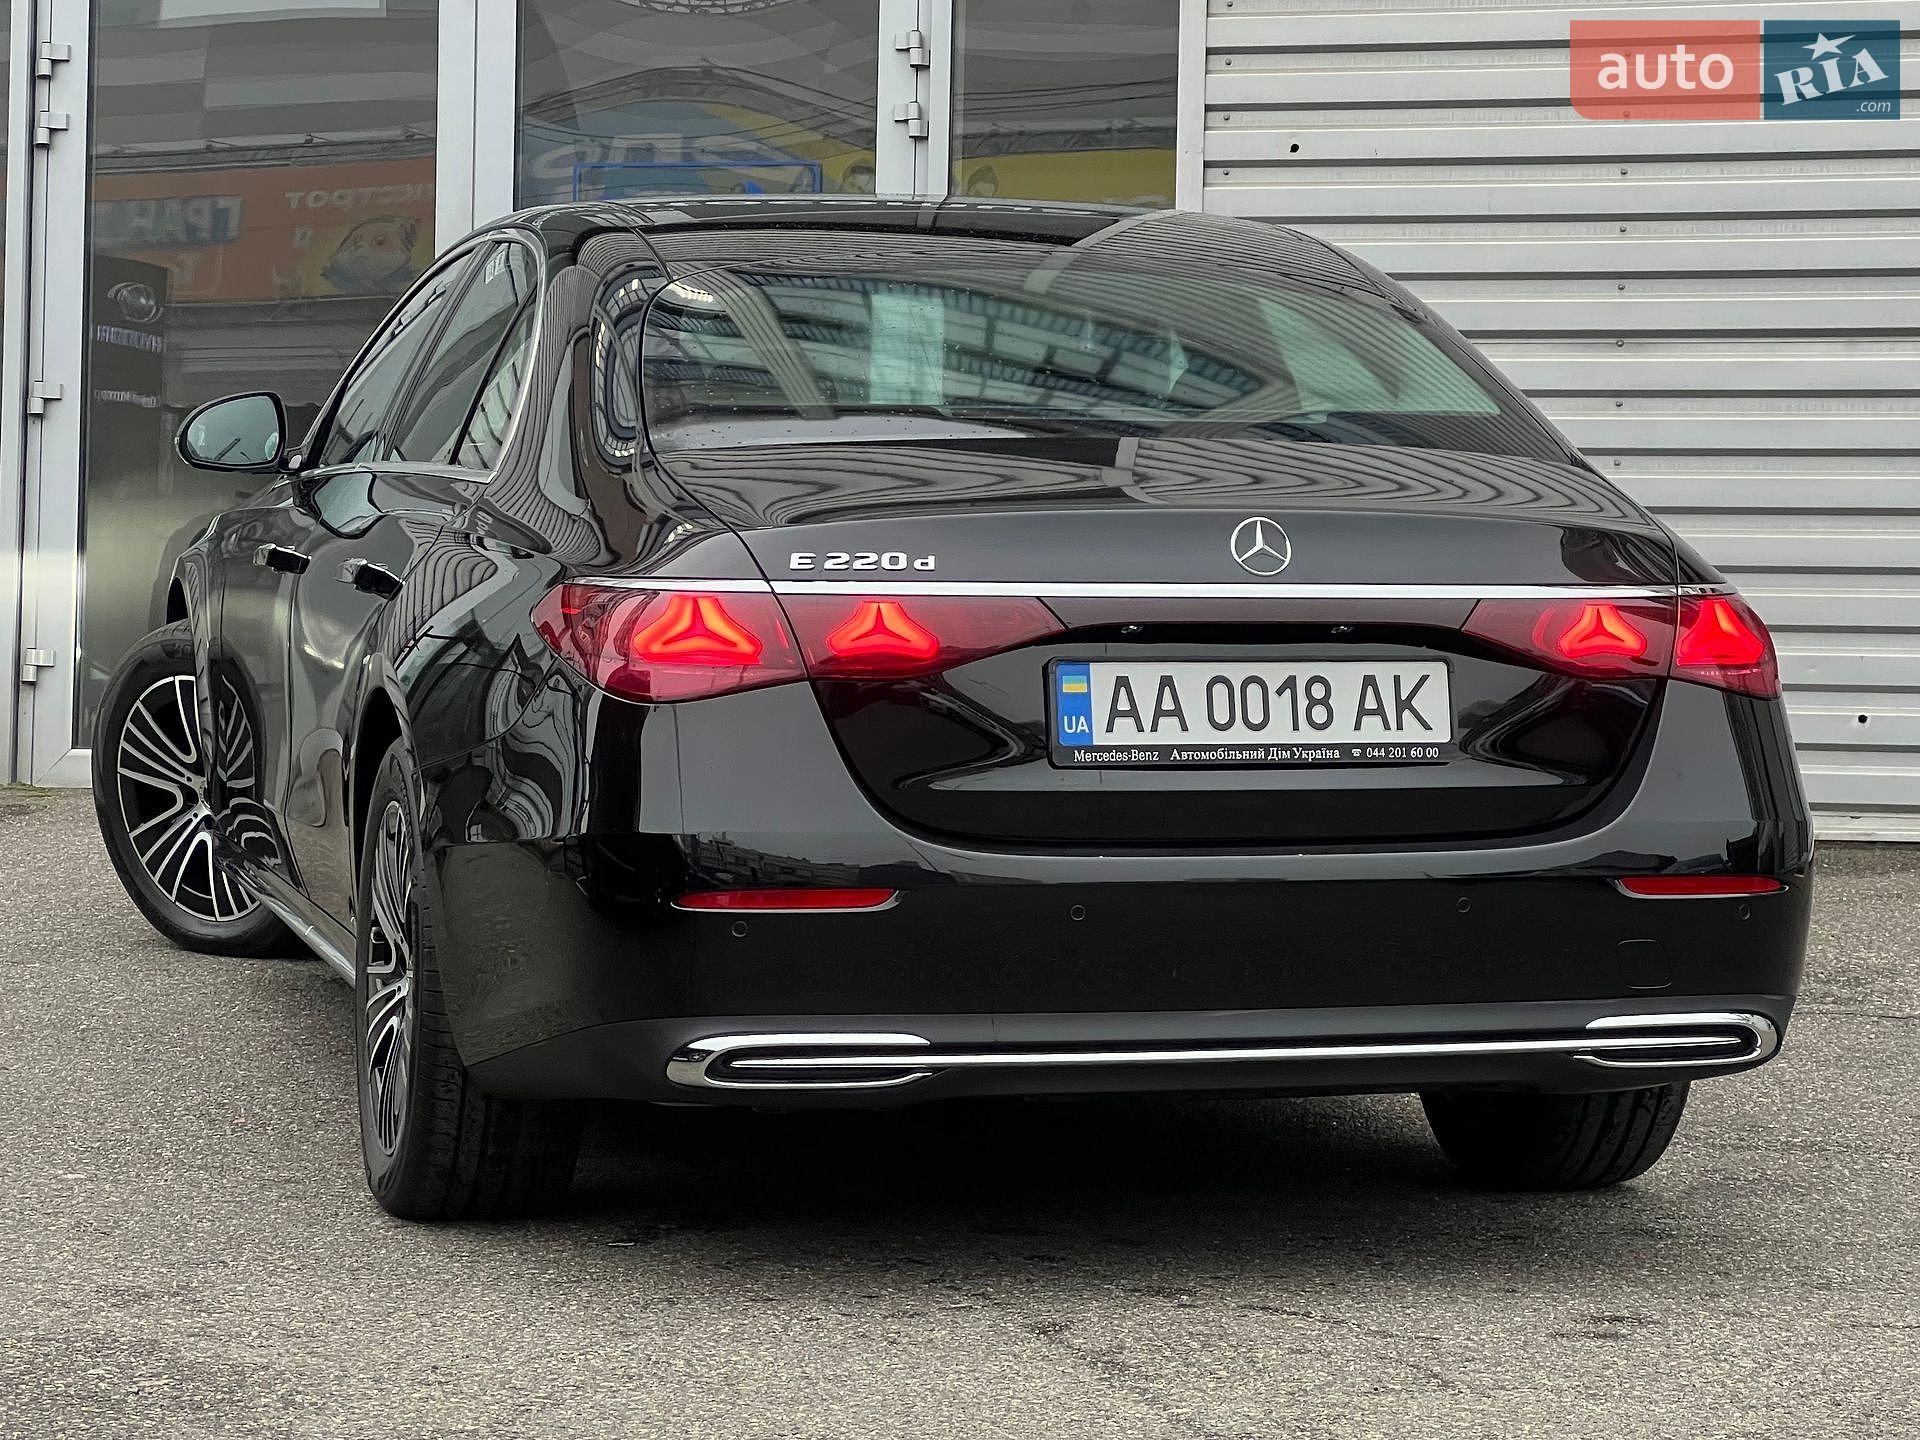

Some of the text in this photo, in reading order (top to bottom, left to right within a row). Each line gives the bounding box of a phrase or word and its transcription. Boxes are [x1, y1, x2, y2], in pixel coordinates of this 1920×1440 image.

[789, 552, 936, 571] E 220 d
[1105, 674, 1433, 732] AA 0018 AK
[1063, 715, 1090, 733] UA
[1073, 747, 1439, 762] Mercedes-Benz Автомобільний Дім Україна 044 201 60 00
